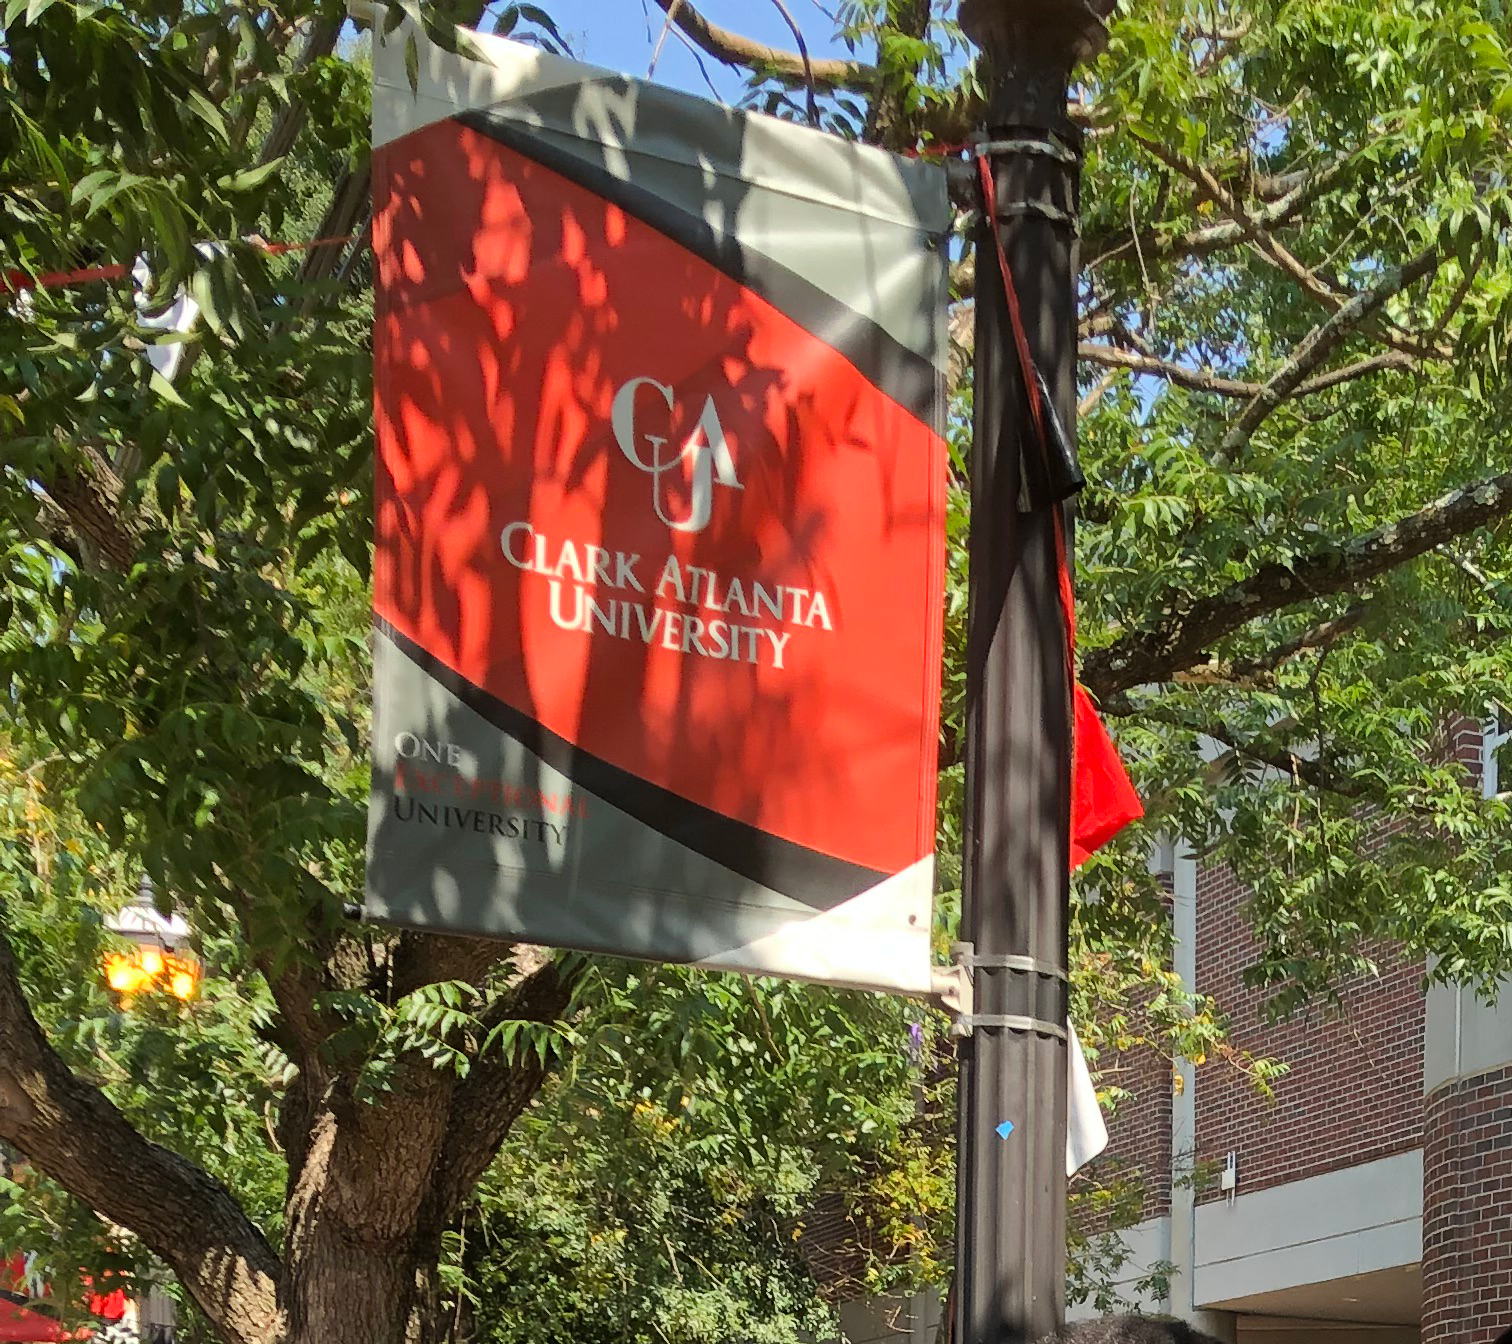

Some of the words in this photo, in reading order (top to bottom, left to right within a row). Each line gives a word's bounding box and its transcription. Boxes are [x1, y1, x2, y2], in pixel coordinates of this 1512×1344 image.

[500, 521, 645, 594] CLARK
[656, 554, 833, 632] ATLANTA
[548, 579, 791, 670] UNIVERSITY
[394, 731, 463, 767] ONE
[394, 796, 568, 846] UNIVERSITY
